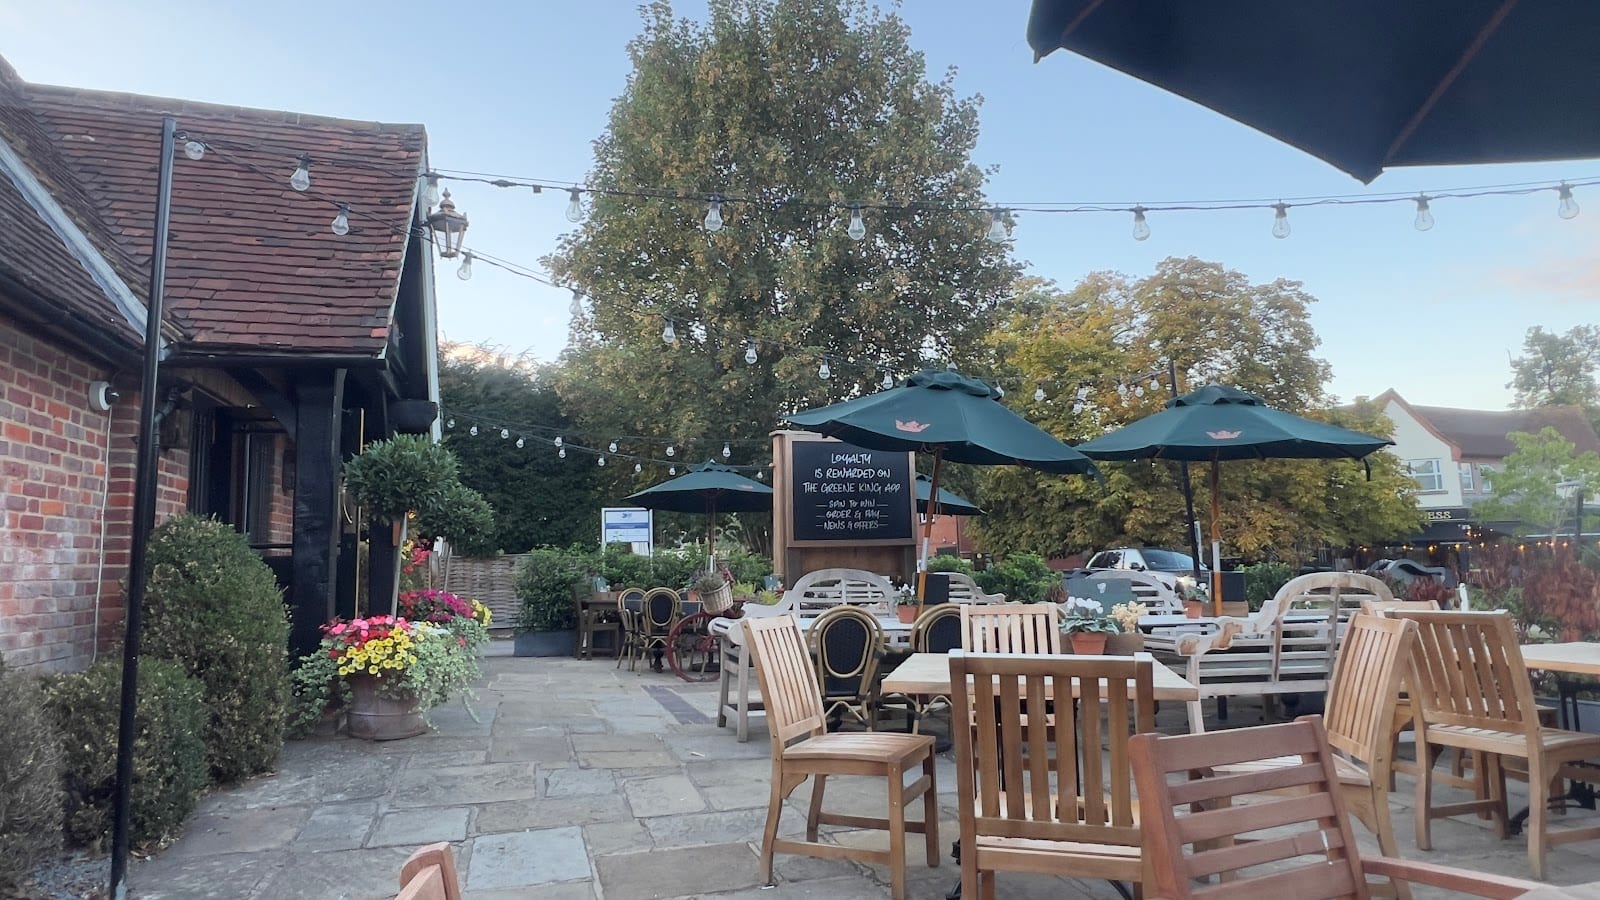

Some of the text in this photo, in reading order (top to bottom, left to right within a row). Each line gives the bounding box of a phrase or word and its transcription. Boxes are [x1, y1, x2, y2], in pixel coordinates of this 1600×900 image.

[831, 453, 872, 464] LOYALTY
[815, 468, 890, 479] IS REWARDED ON
[803, 482, 901, 494] THE GREENE KING APP
[860, 500, 875, 508] WIN
[826, 510, 851, 519] ORDER
[1427, 511, 1452, 520] ESS
[824, 521, 845, 530] NEWS
[854, 520, 879, 529] OFFERS
